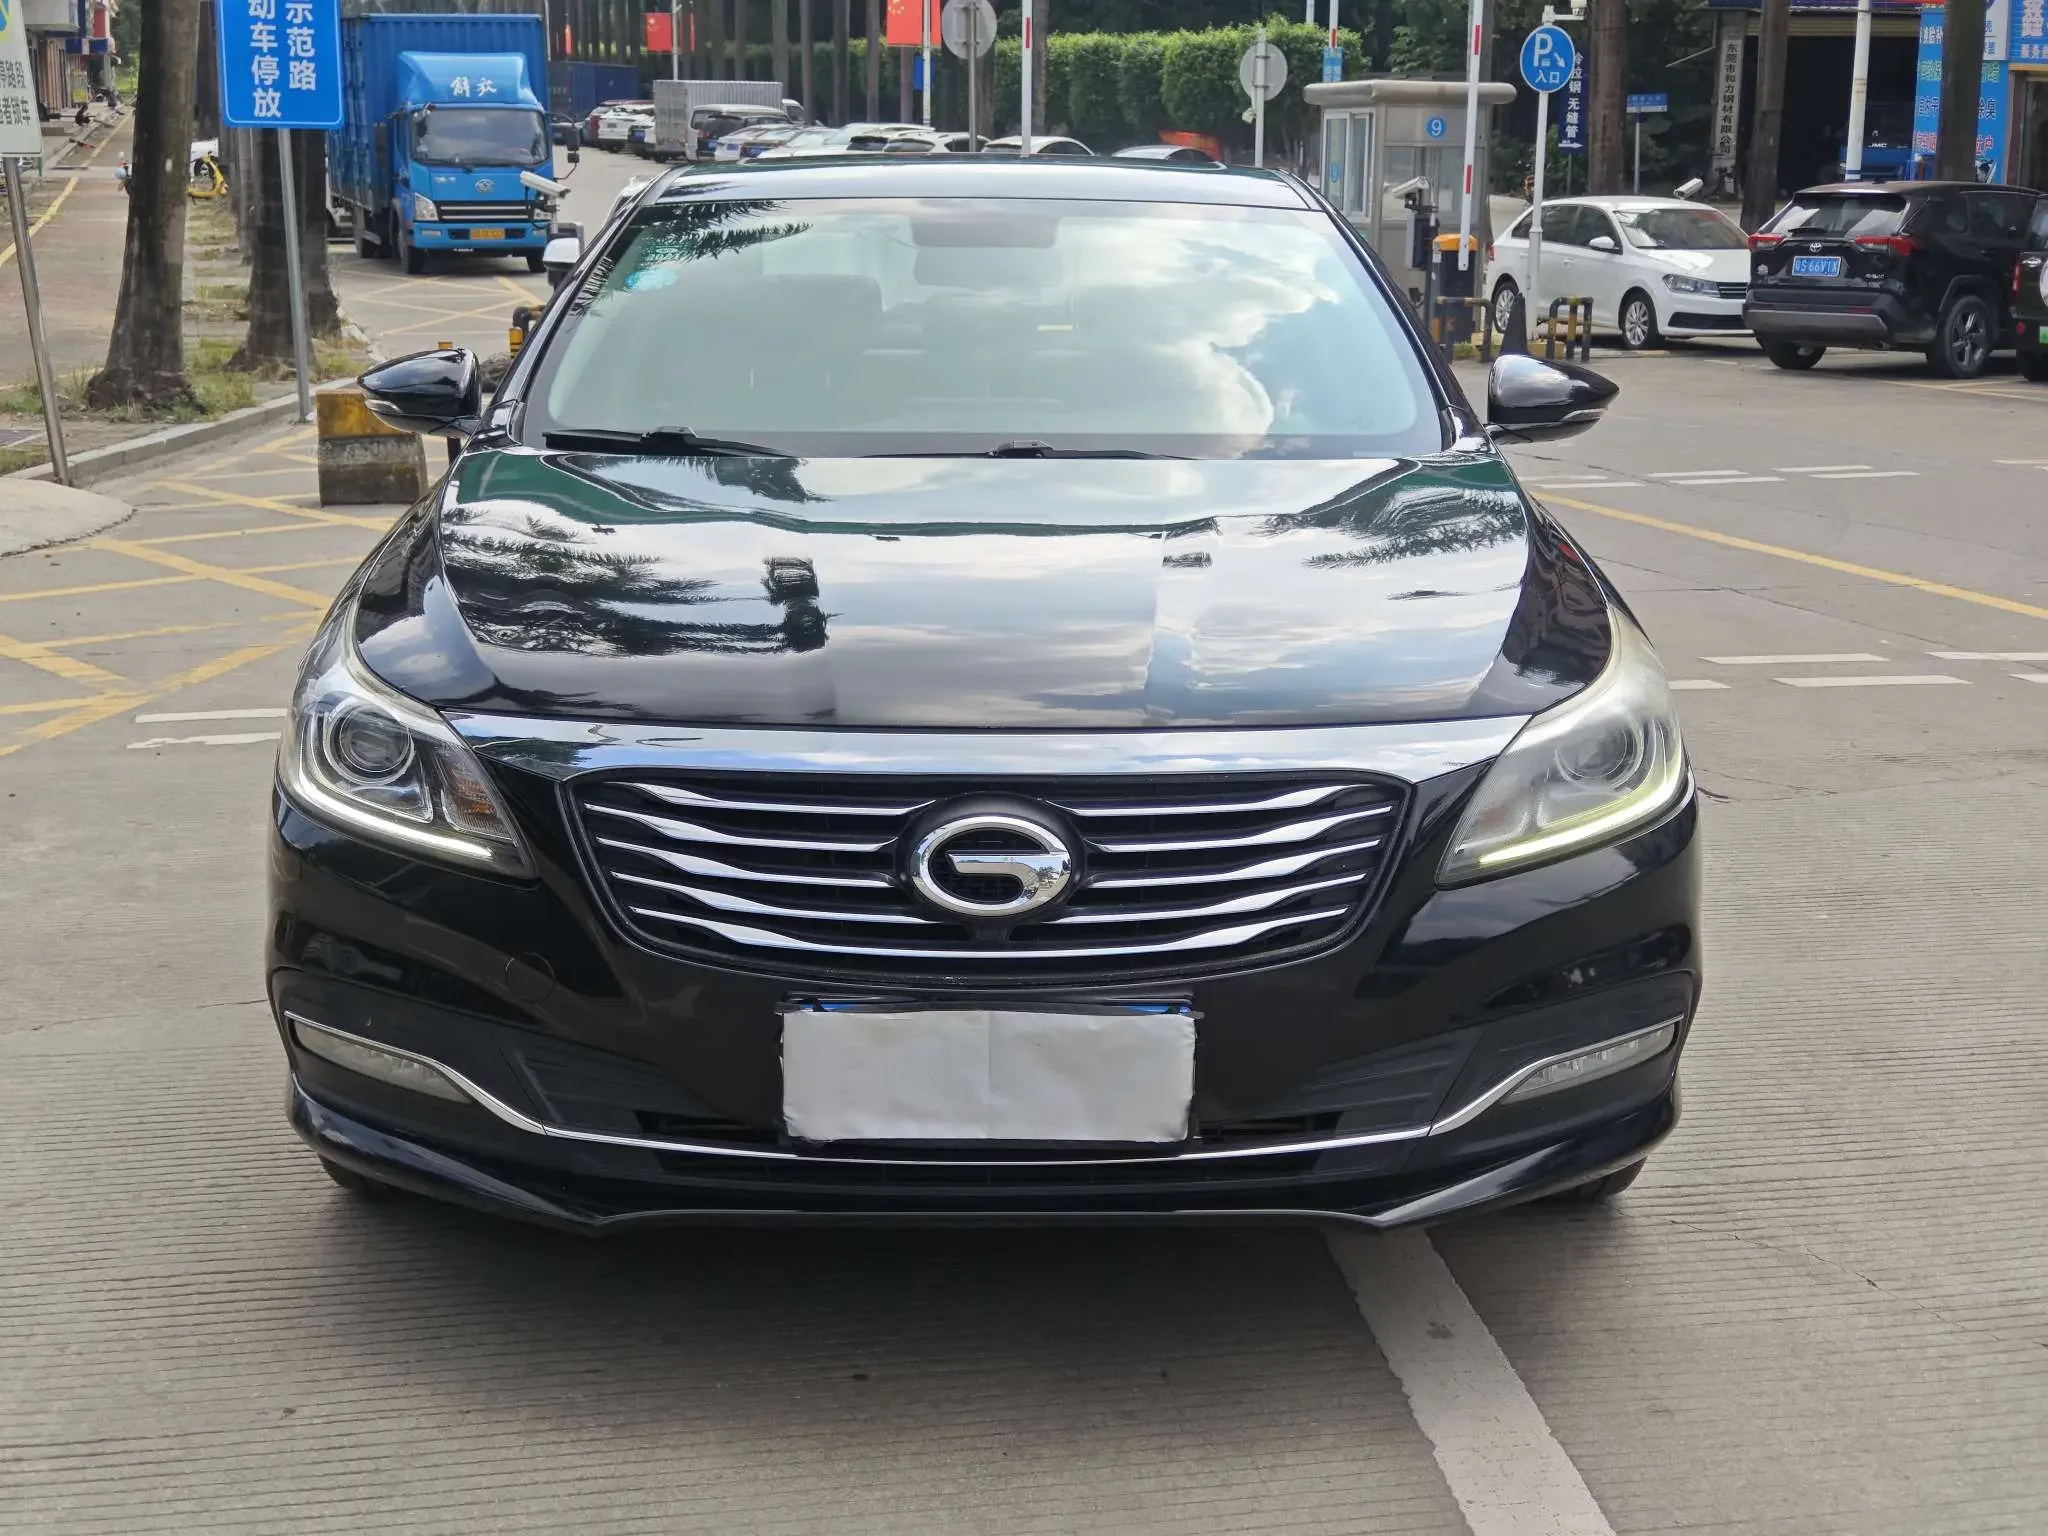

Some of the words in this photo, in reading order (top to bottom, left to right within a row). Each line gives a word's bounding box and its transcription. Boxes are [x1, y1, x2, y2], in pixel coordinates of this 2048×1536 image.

[248, 0, 282, 117] 动车停放
[285, 0, 317, 90] 示范路
[1533, 33, 1552, 67] P
[1535, 70, 1560, 84] 入口
[1431, 119, 1443, 137] 9
